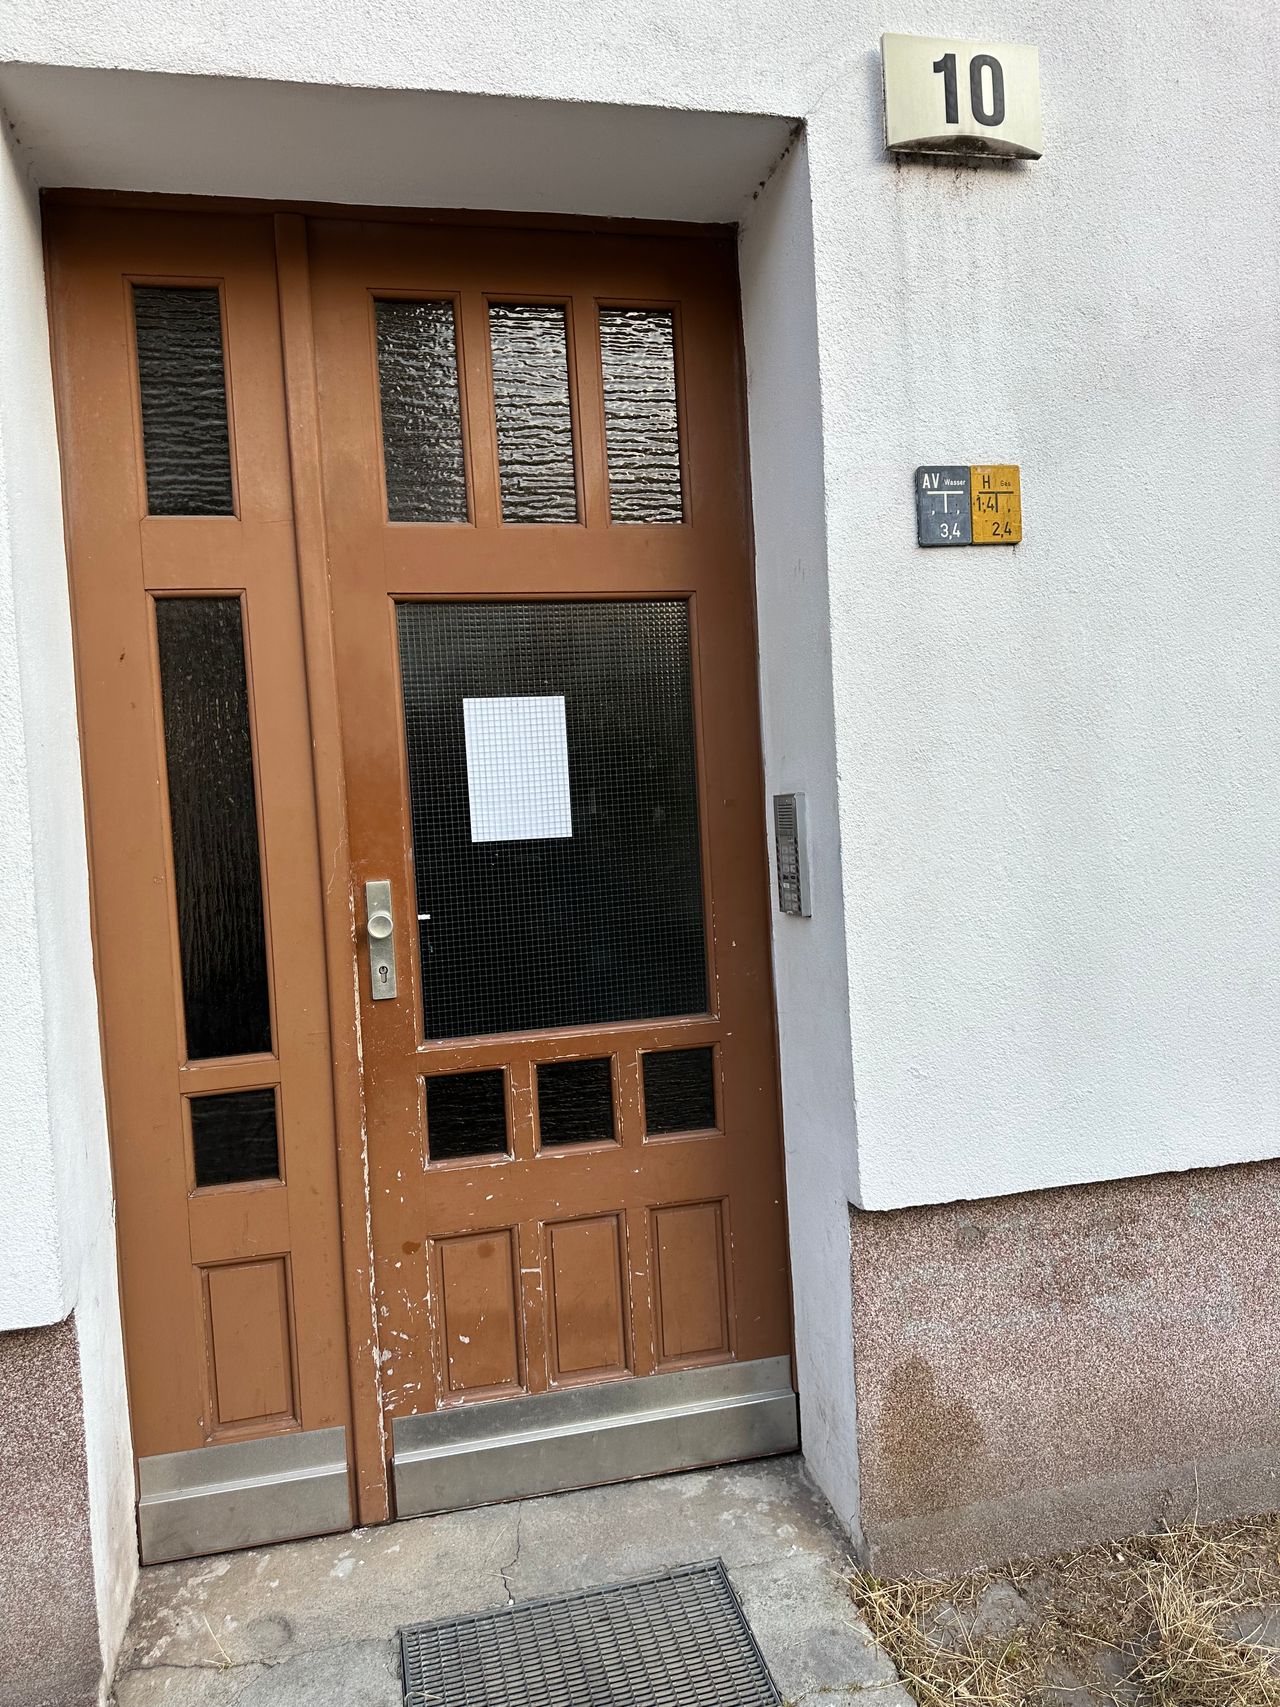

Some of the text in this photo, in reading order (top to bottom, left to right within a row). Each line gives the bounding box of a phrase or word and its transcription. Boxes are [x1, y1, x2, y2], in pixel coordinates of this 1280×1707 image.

[933, 53, 1005, 127] 10
[922, 473, 940, 489] AV
[982, 475, 991, 489] H
[940, 523, 961, 540] 3,4
[992, 522, 1012, 538] 2,4
